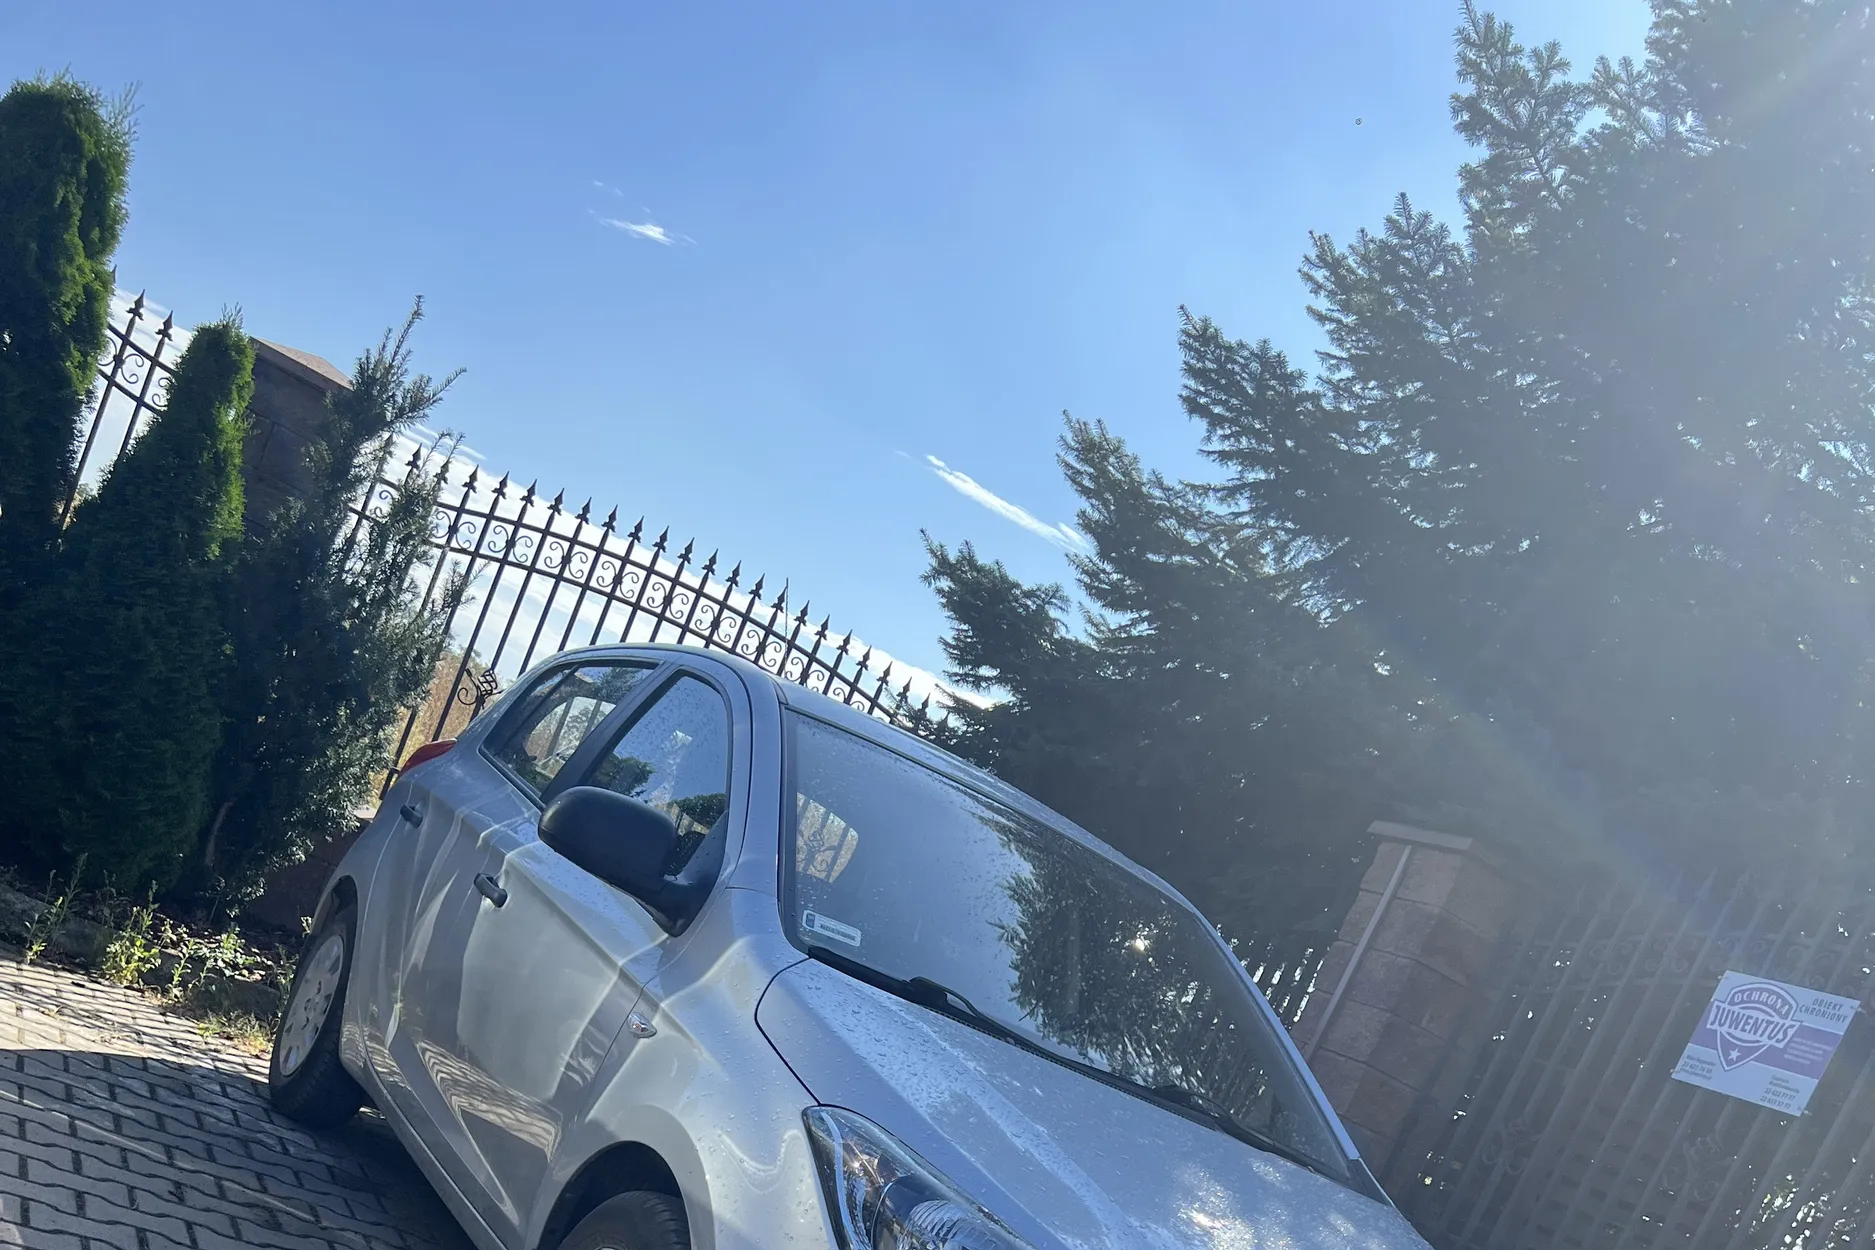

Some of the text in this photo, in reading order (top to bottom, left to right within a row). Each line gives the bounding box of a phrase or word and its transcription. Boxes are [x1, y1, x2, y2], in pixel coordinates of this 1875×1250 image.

[1734, 990, 1790, 1016] OCHRONA
[1812, 998, 1844, 1012] OBIEKT
[1710, 1005, 1796, 1044] JUWENTUS
[1799, 1005, 1849, 1024] CHRONIONY
